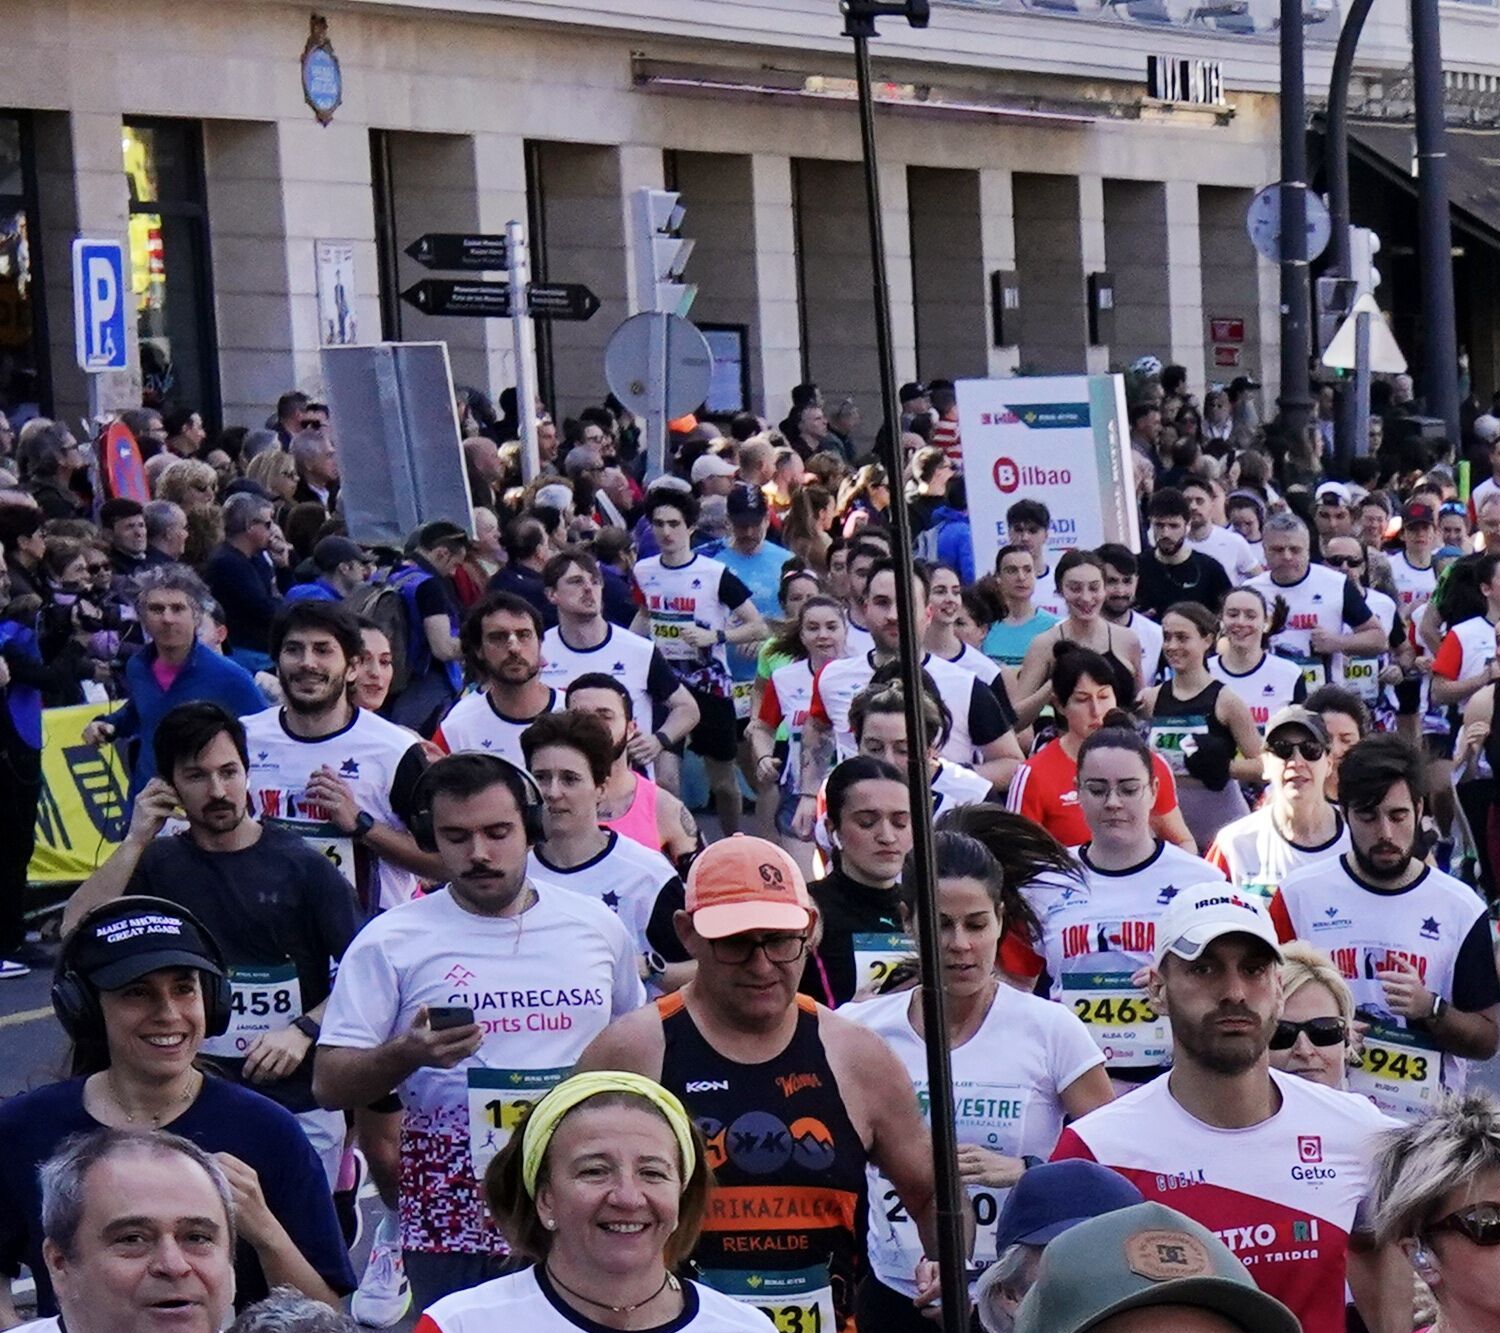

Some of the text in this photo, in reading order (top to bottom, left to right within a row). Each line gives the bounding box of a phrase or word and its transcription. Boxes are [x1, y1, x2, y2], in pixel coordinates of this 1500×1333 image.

[994, 459, 1072, 491] Bilbao
[995, 519, 1077, 537] EADI
[106, 924, 181, 943] GREAT AGAIN
[447, 989, 603, 1012] CUATRECASAS
[525, 1011, 572, 1031] Club
[1290, 1165, 1337, 1181] Getxo
[722, 1234, 809, 1252] REKALDE
